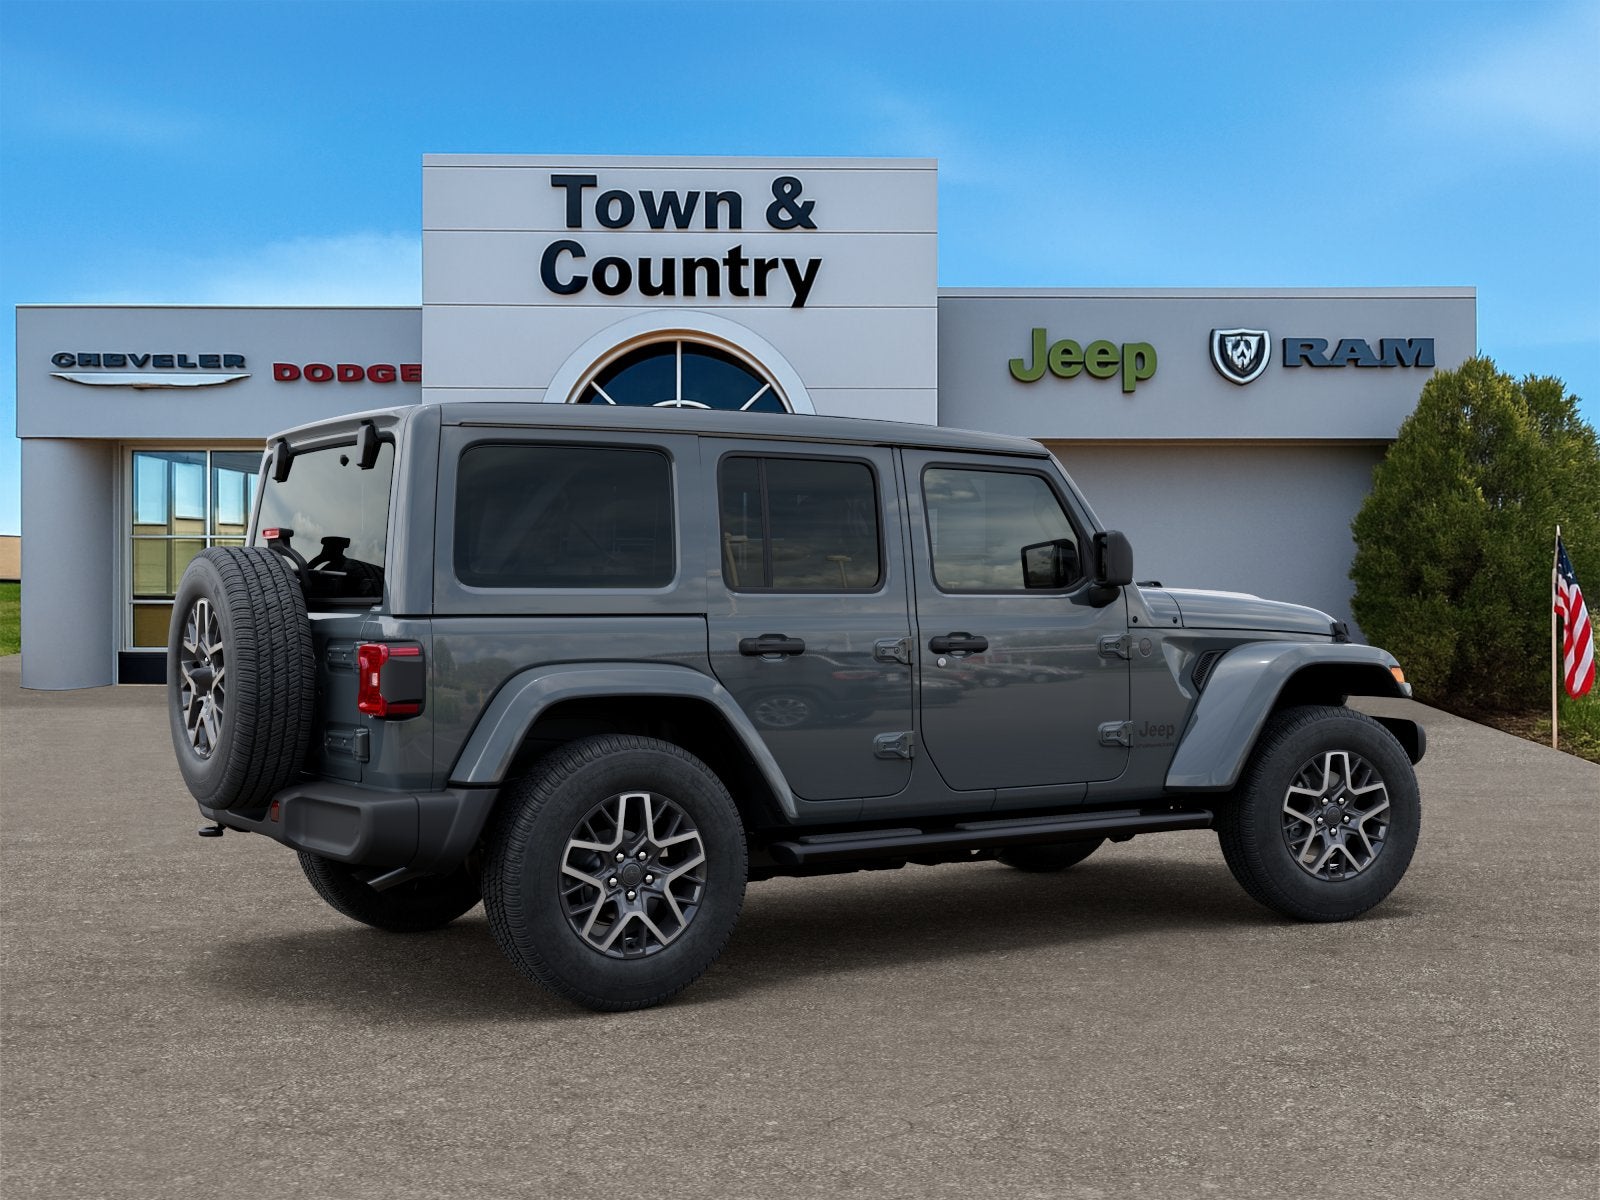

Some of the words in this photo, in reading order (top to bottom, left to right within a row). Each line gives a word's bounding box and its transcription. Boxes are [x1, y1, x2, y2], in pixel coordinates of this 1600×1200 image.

[550, 174, 742, 229] Town
[765, 176, 818, 230] &
[540, 239, 822, 308] Country
[272, 362, 422, 384] DODGE
[1009, 328, 1157, 393] Jeep
[1282, 337, 1435, 368] RAM
[1139, 722, 1175, 739] Jeep
